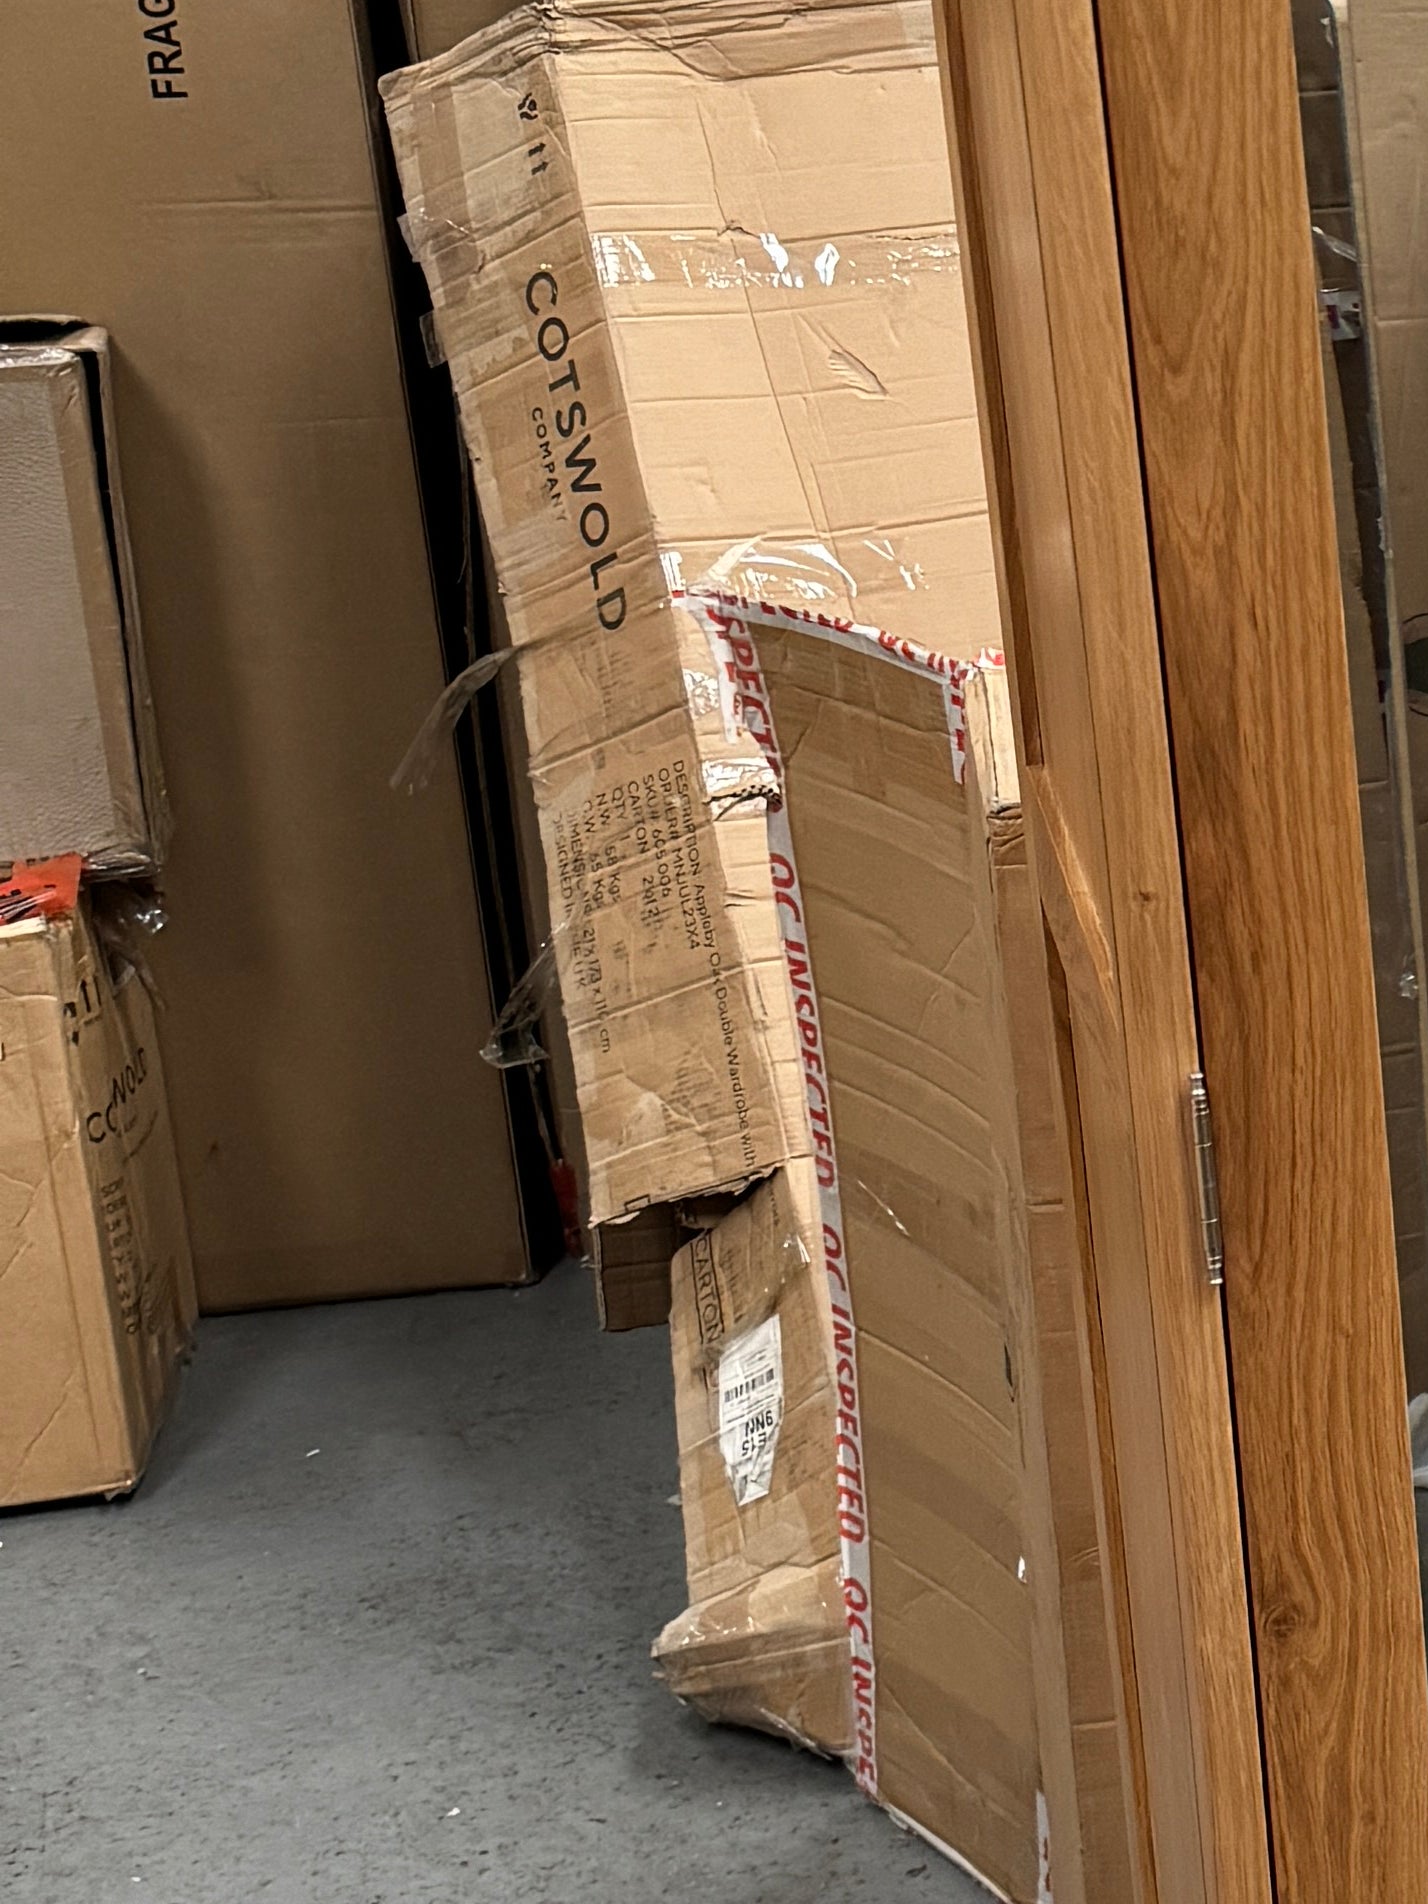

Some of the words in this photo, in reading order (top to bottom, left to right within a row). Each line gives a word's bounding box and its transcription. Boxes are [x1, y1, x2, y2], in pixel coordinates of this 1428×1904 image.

[520, 268, 632, 634] COTSWOLD
[529, 406, 567, 523] COMPANY
[692, 882, 717, 949] Appleby
[597, 1027, 614, 1053] cm
[713, 986, 736, 1046] Double
[724, 1052, 752, 1131] Wardrobe
[738, 1132, 757, 1168] with
[687, 1236, 725, 1344] CARTON
[842, 1576, 871, 1645] QC
